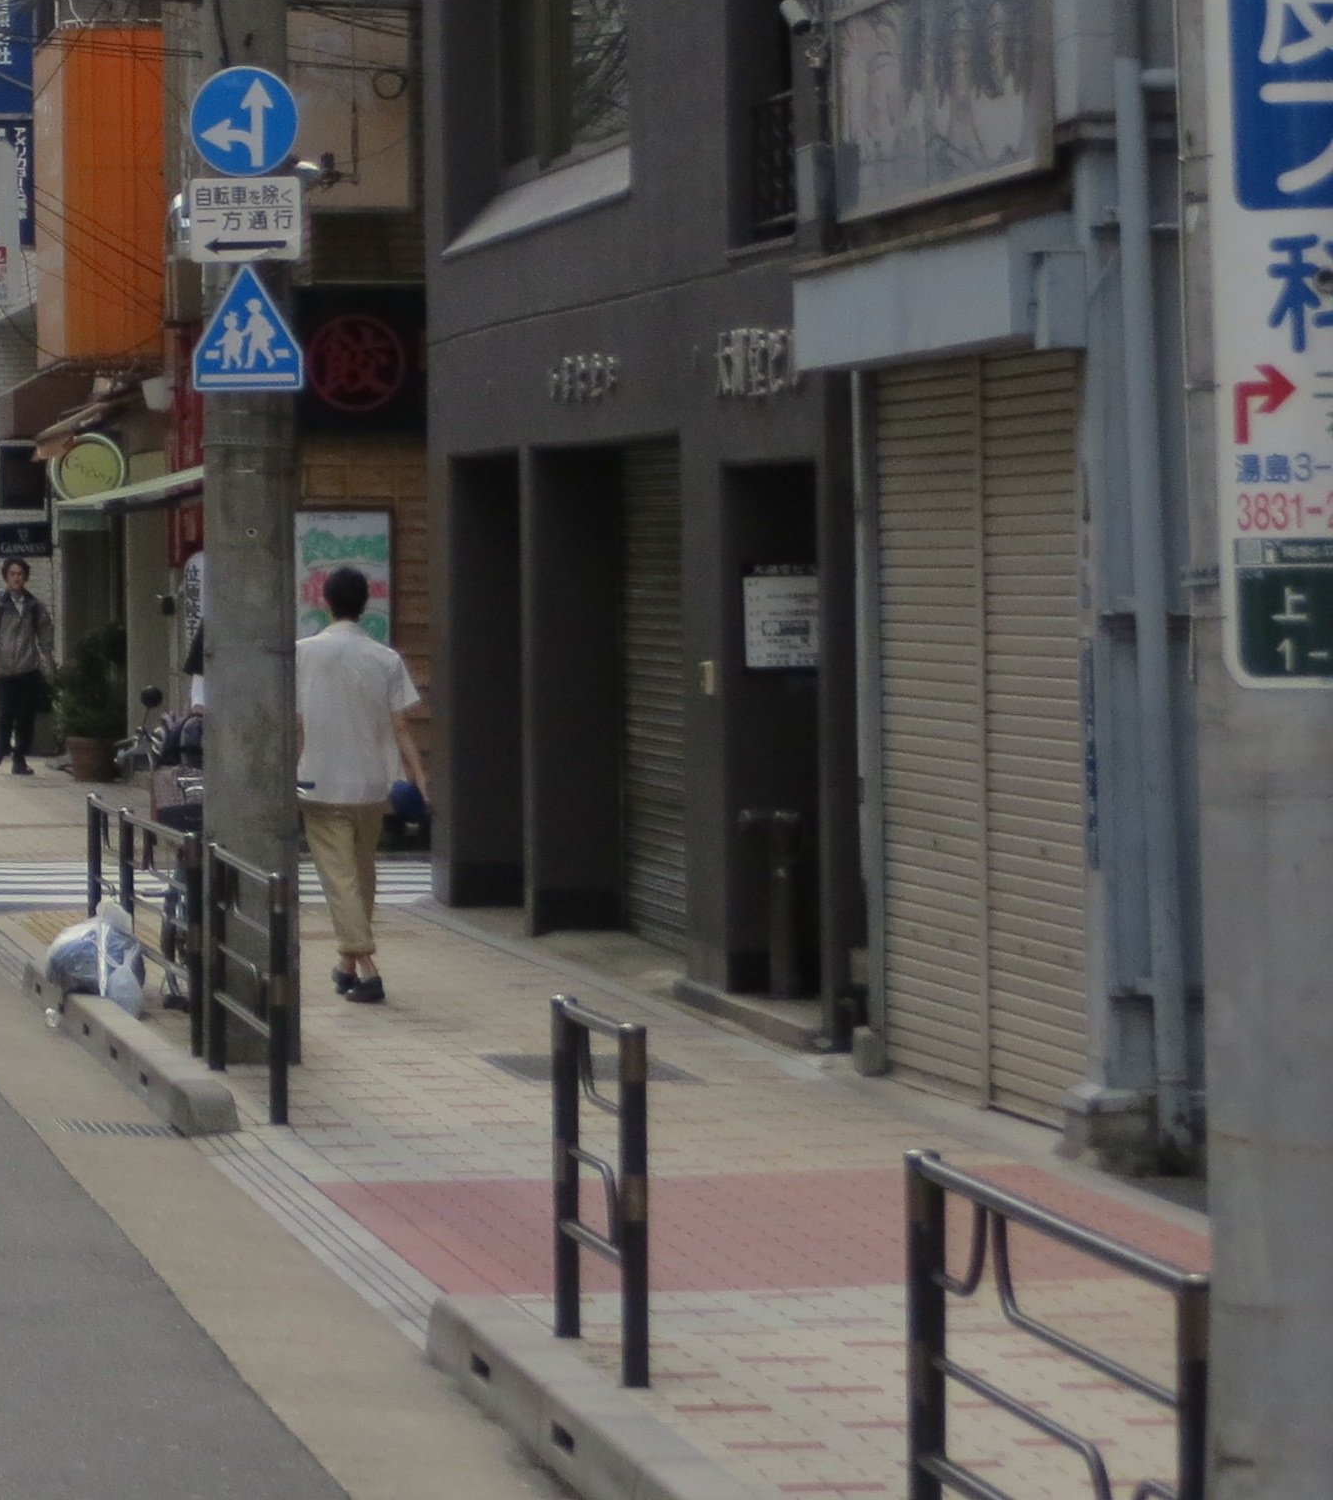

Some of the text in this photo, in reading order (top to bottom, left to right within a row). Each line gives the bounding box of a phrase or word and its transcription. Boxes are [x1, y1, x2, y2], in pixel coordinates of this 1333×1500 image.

[195, 186, 293, 208] 自転車を除く
[196, 209, 294, 231] 一方通行
